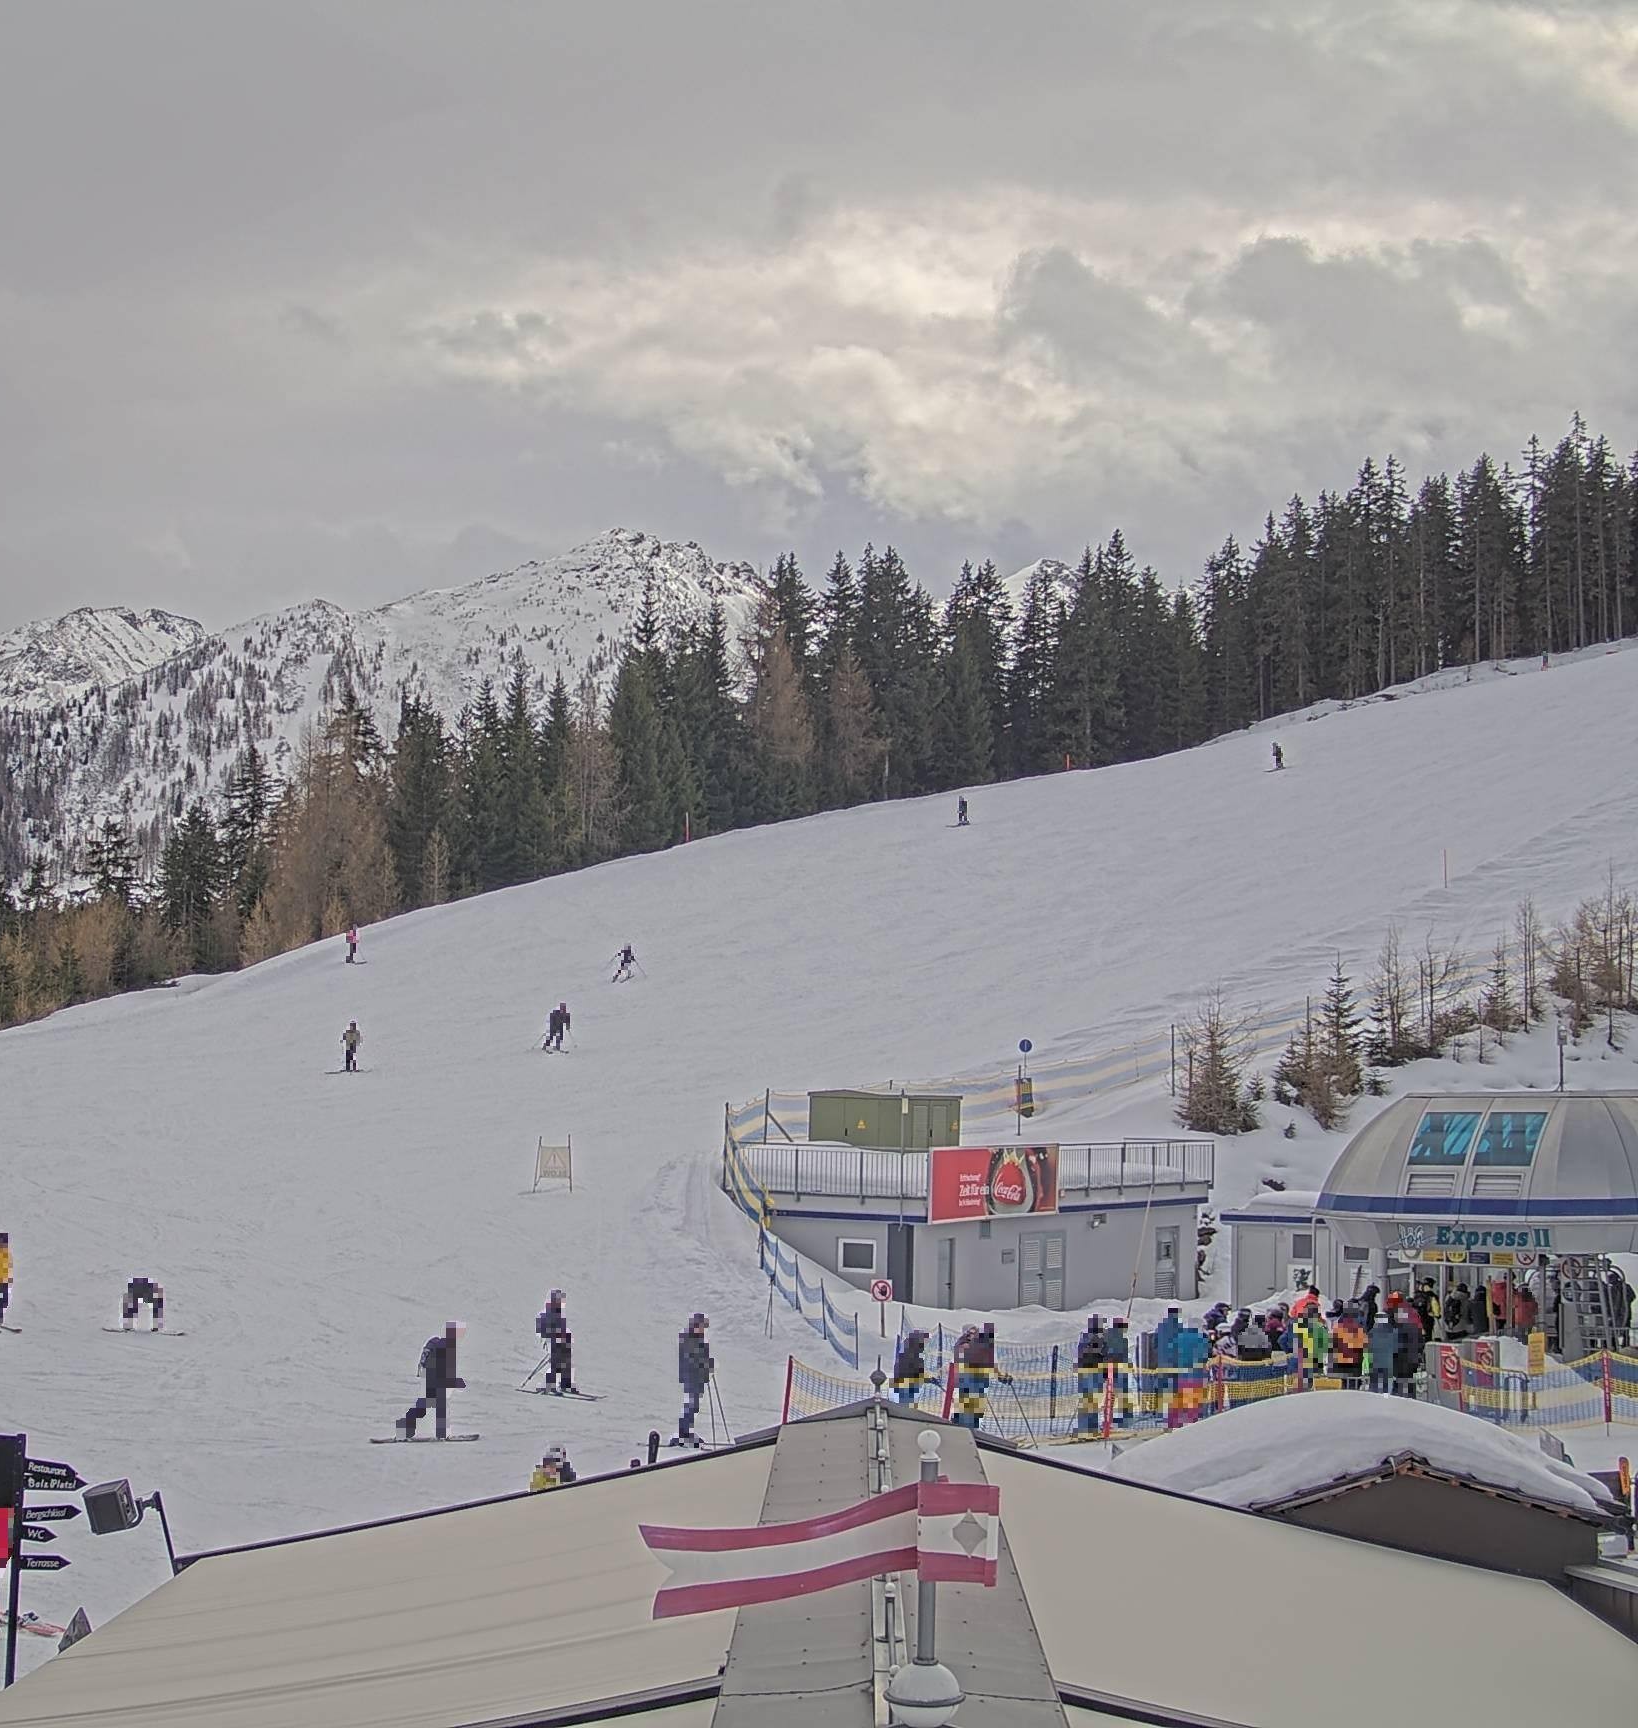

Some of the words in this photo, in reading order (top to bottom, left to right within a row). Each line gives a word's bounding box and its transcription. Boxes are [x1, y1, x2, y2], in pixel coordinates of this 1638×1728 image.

[1436, 1225, 1529, 1250] Express
[28, 1461, 67, 1476] Restaurant
[27, 1528, 46, 1540] WC
[27, 1557, 60, 1568] Terrasse
